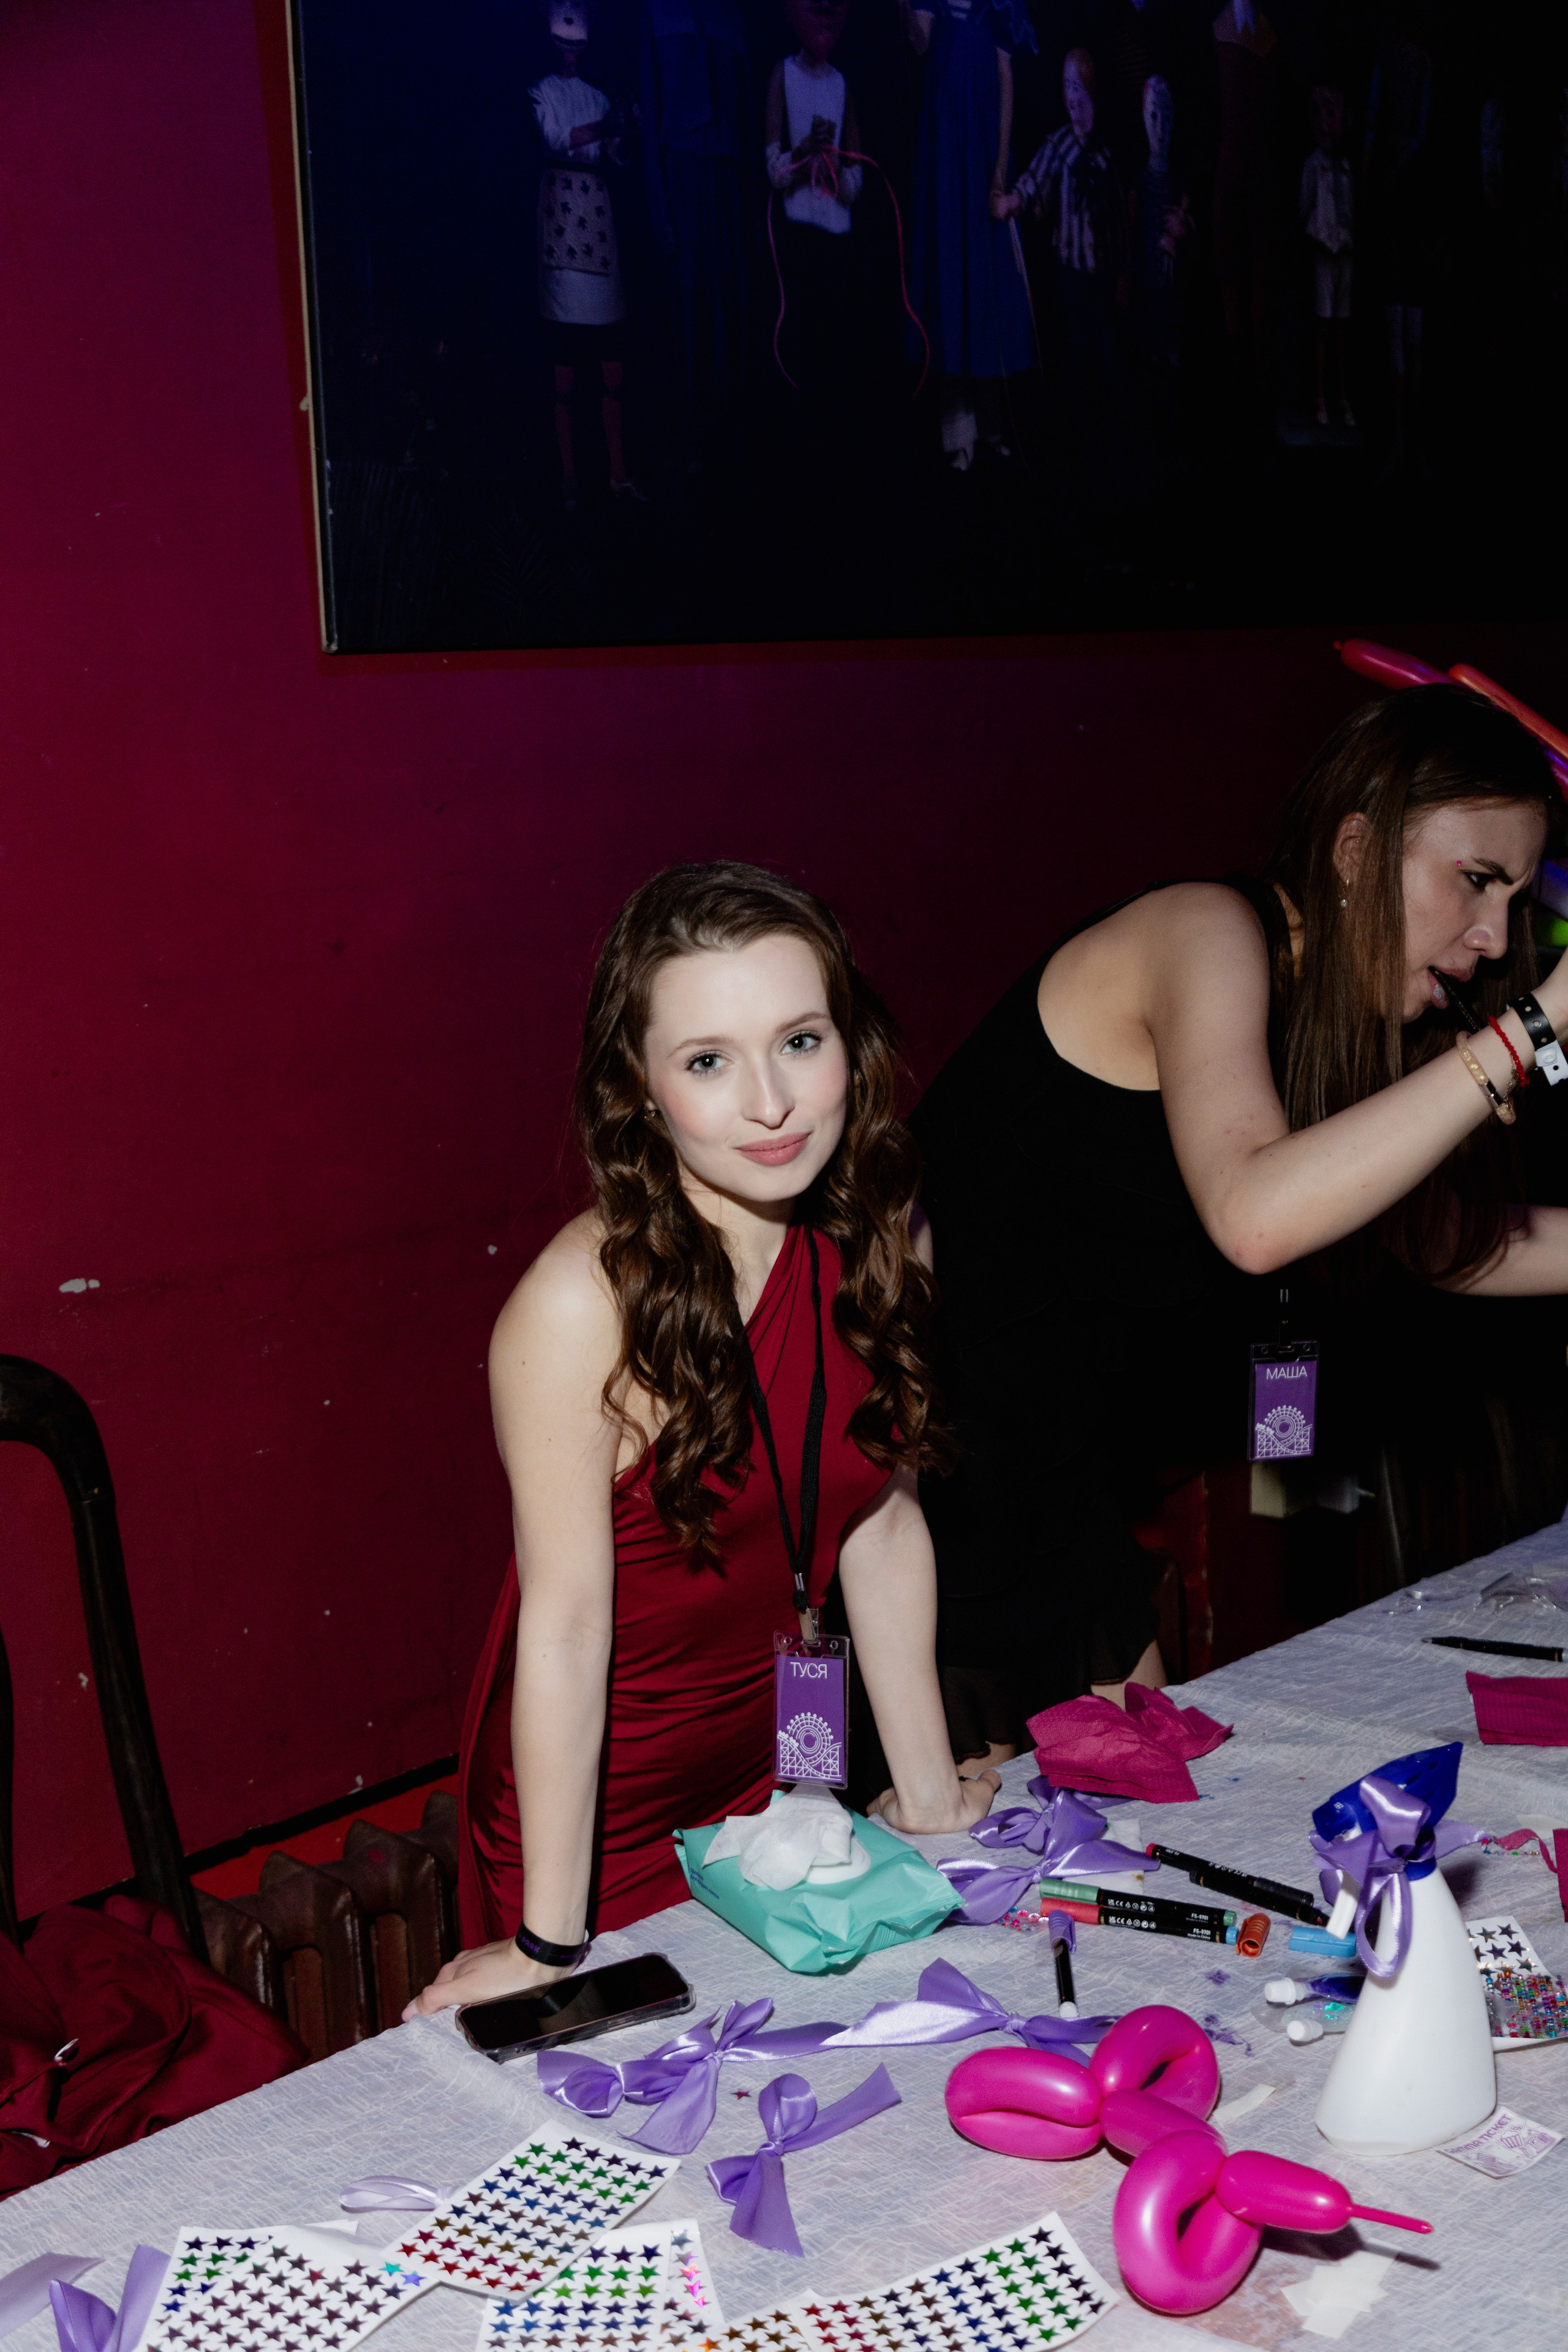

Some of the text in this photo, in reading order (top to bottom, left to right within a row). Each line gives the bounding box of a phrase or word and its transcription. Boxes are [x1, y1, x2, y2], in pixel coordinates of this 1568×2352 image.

[1266, 1366, 1308, 1379] МАША
[790, 1662, 827, 1678] ТУСЯ
[1478, 2114, 1512, 2141] TICKET
